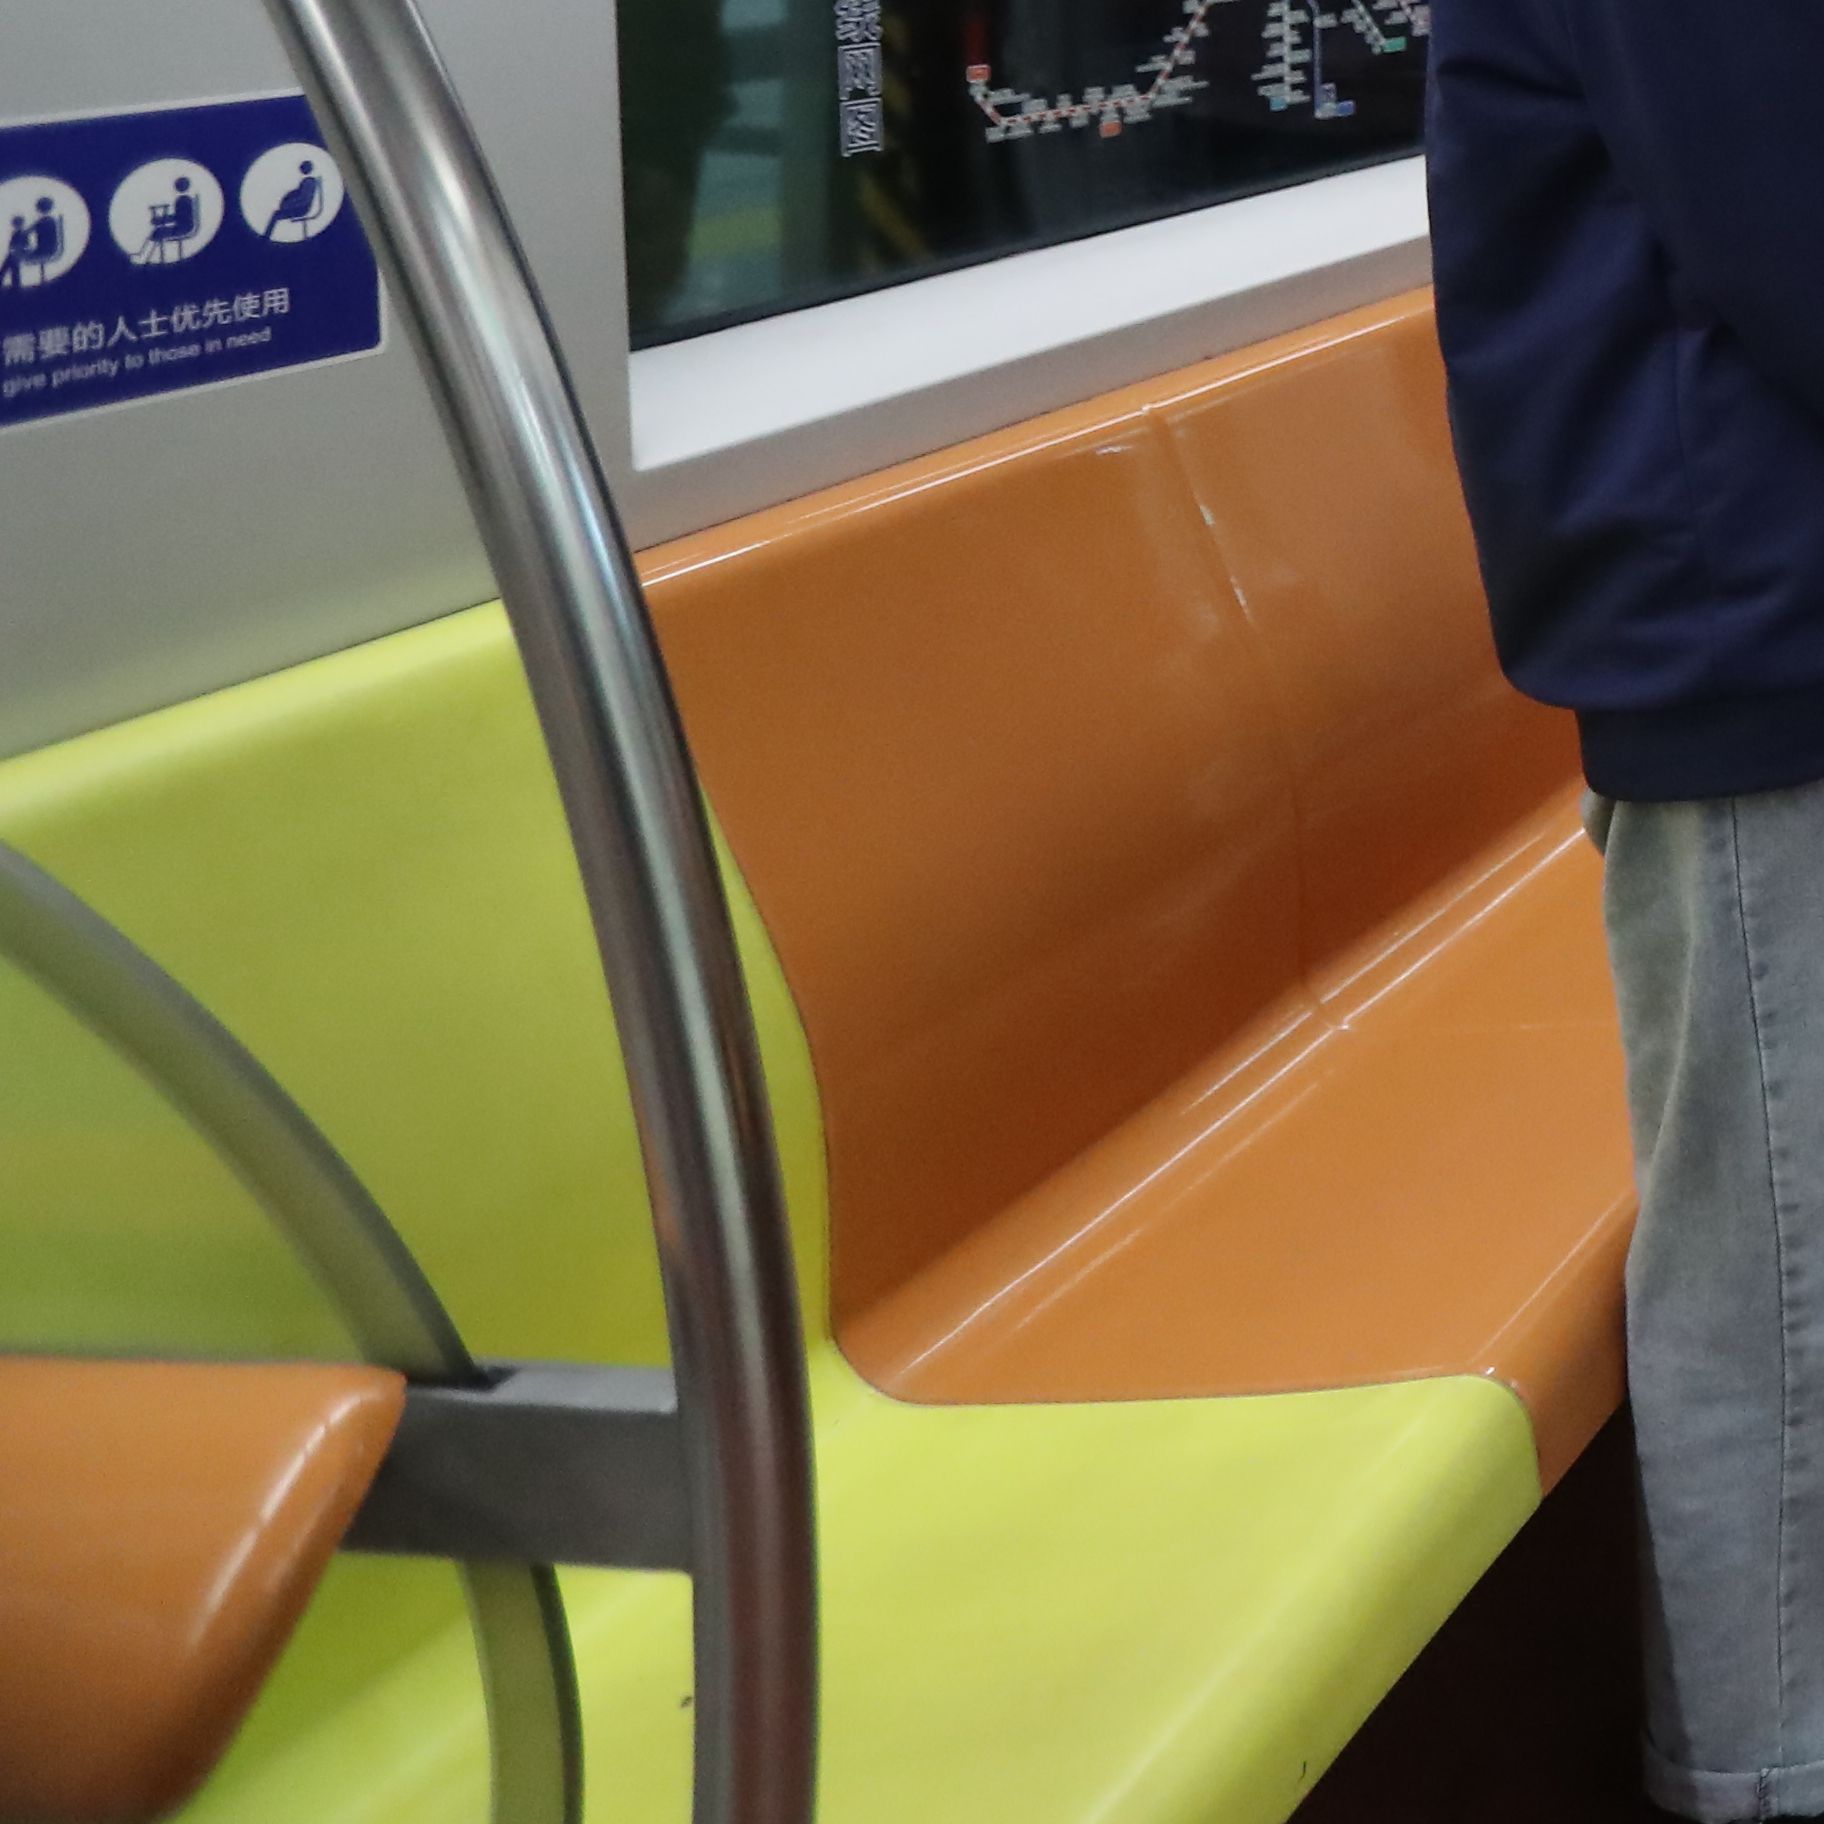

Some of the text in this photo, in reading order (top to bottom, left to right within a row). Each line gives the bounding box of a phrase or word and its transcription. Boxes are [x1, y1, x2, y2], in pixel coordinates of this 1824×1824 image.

[2, 286, 290, 368] 需要的人士优先使用
[3, 325, 272, 398] give priority to those in need
